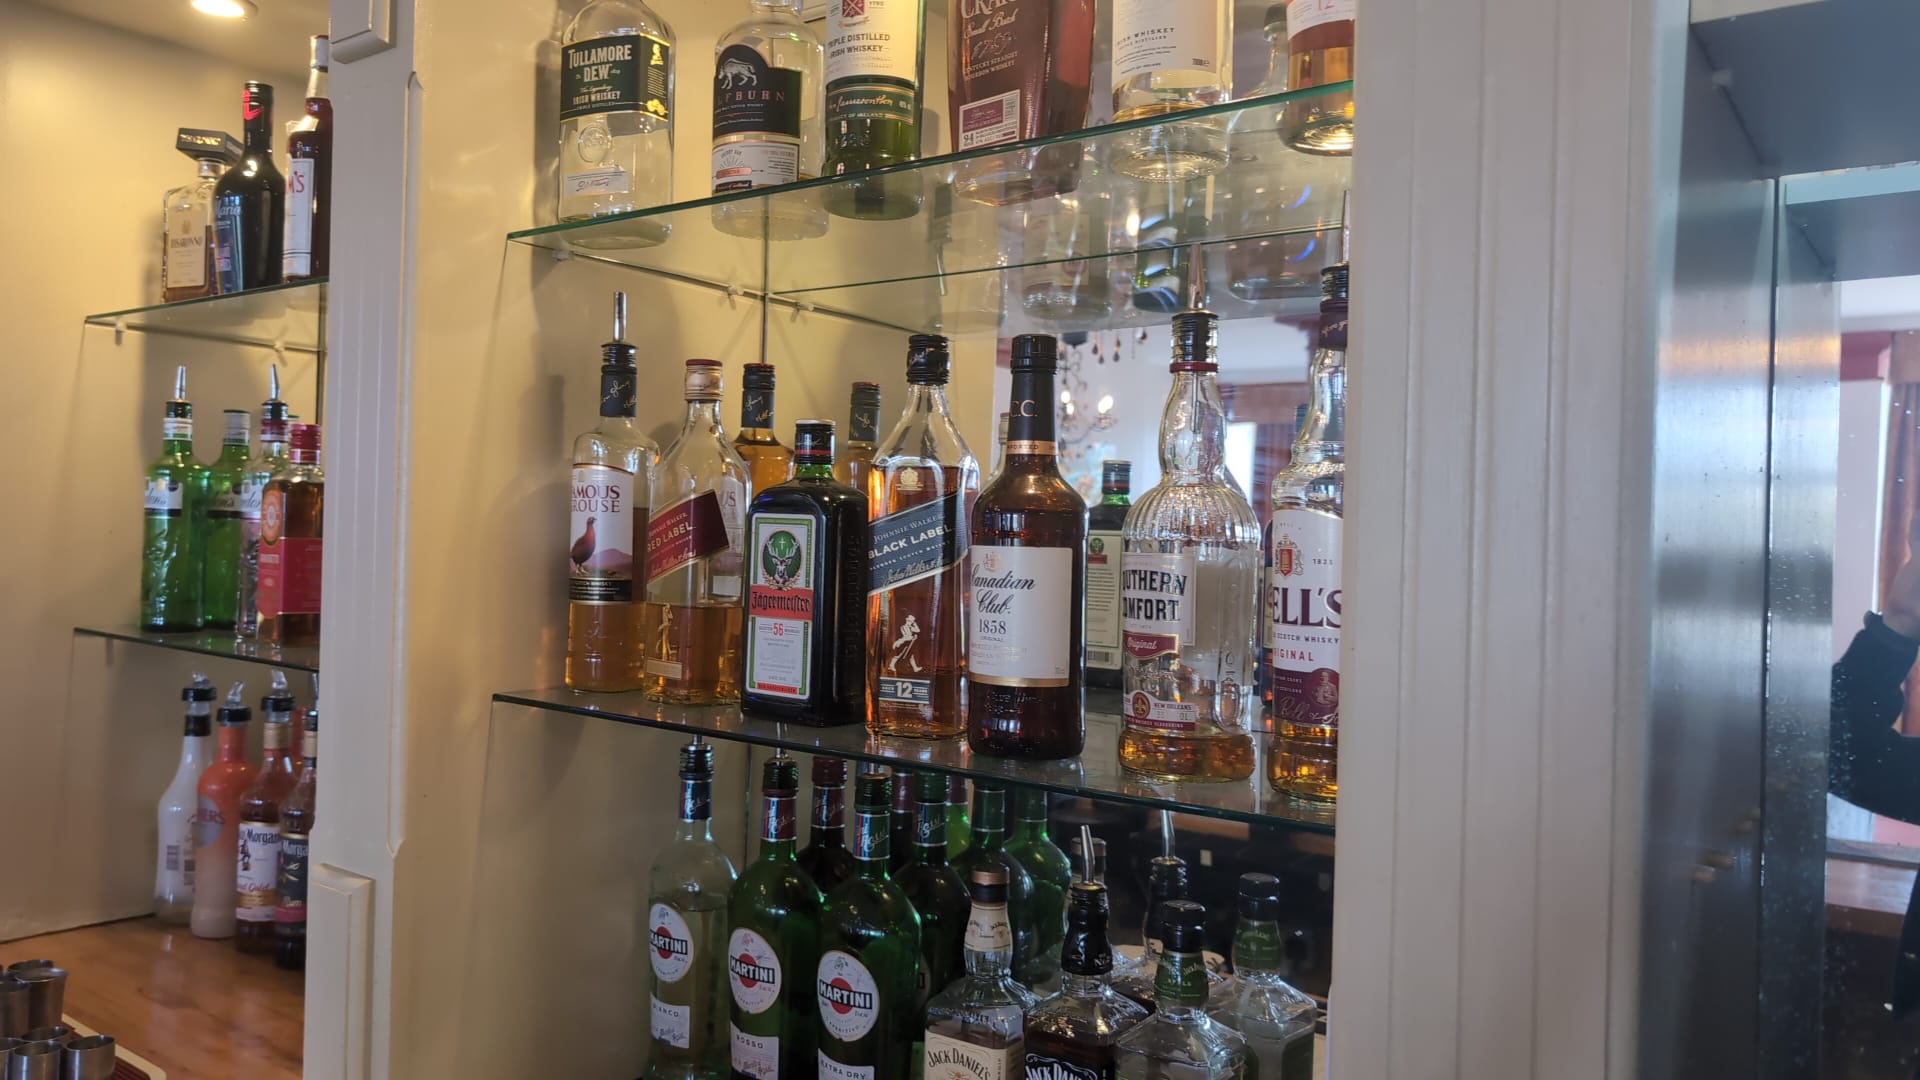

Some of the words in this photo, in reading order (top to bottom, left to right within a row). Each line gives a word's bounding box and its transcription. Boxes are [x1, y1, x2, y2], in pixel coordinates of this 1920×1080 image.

[848, 34, 890, 42] DISTILLED
[1134, 27, 1175, 38] WHISKEY
[568, 44, 633, 69] TULLAMORE
[847, 45, 883, 54] WHISKEY
[583, 64, 610, 83] DEW
[590, 91, 620, 102] WHISKEY
[663, 521, 693, 543] LABEL
[873, 524, 909, 544] JOHNNIE
[867, 538, 909, 560] BLACK
[910, 524, 952, 544] LABEL
[773, 622, 784, 636] 56
[979, 618, 1007, 635] 1858
[1304, 635, 1340, 644] WHISKY
[895, 681, 913, 699] 12
[730, 957, 775, 984] MARTINI
[819, 980, 873, 1009] MARTINI
[820, 1058, 844, 1076] EXTRA
[846, 1070, 867, 1080] DRY
[928, 1050, 951, 1068] JACK
[952, 1047, 990, 1080] DANIEL'S
